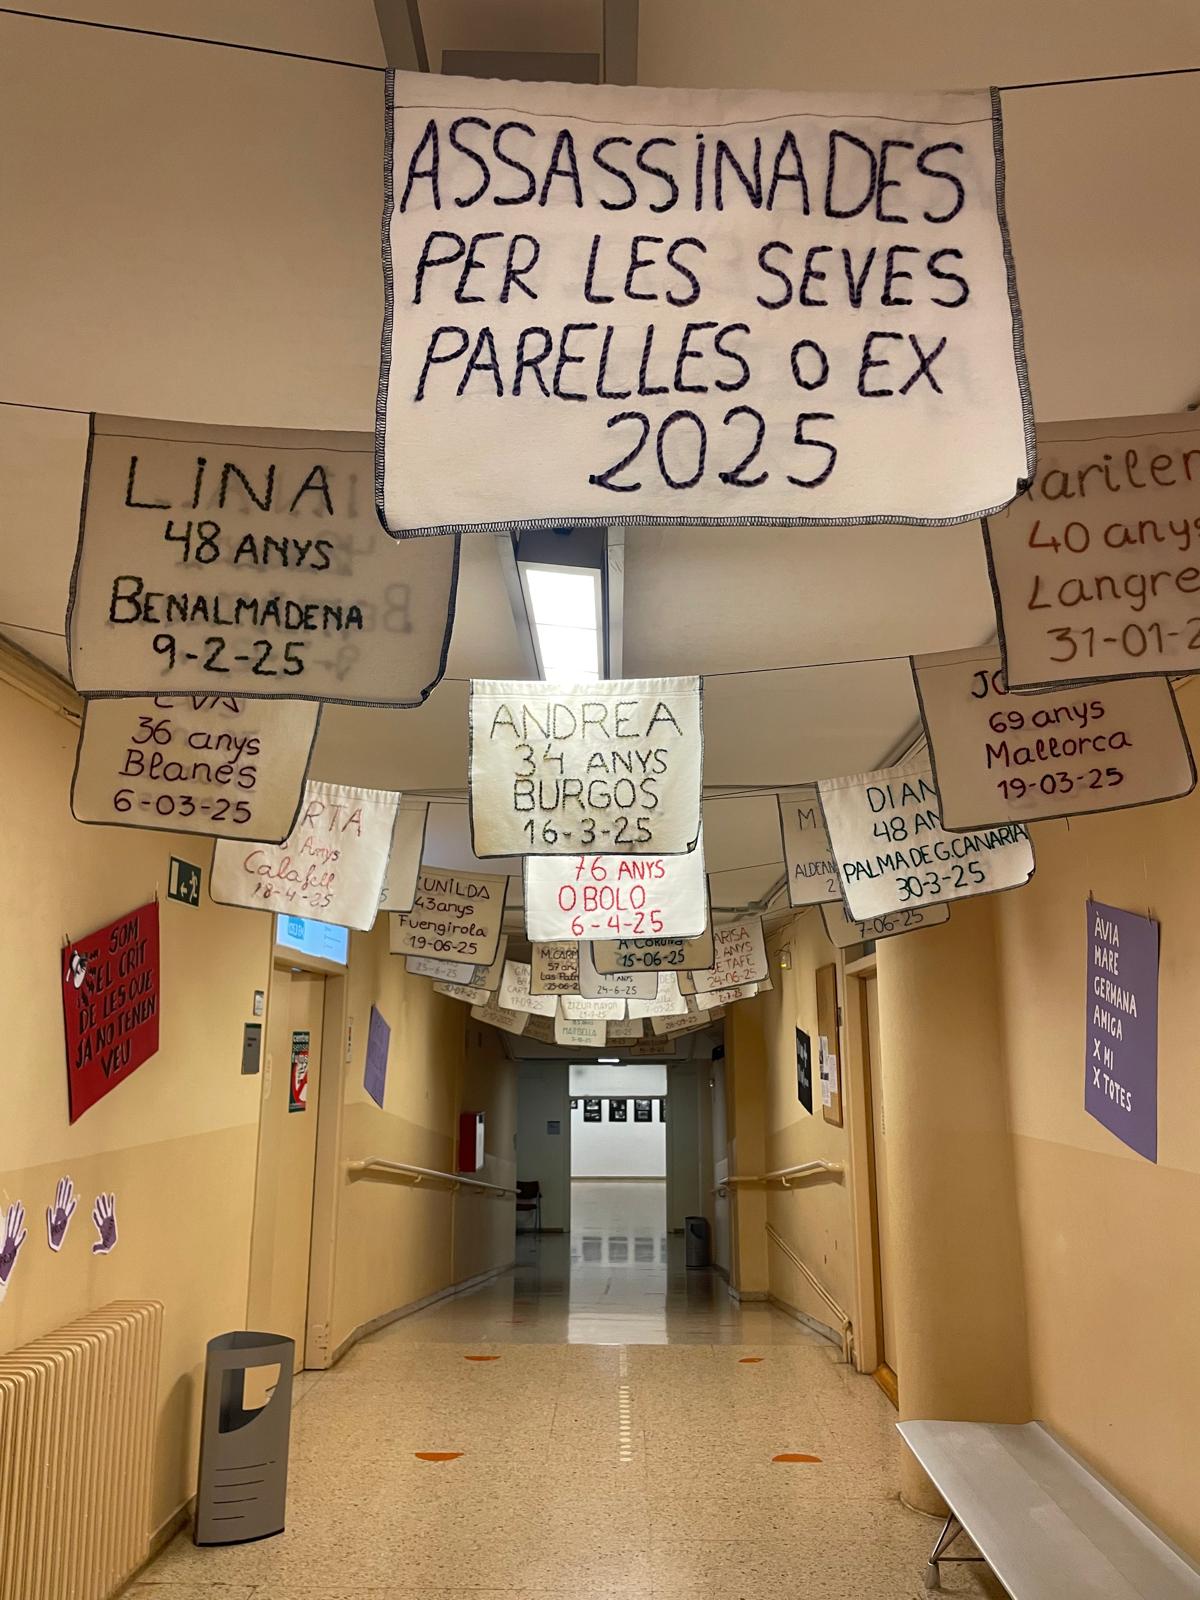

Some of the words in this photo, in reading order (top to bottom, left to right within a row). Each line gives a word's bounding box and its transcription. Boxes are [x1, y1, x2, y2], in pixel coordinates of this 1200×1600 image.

[412, 231, 540, 304] PER
[585, 234, 707, 307] LES
[756, 240, 970, 309] SEVES
[414, 322, 752, 402] PARELLES
[858, 331, 947, 398] EX
[589, 406, 838, 492] 2025
[1020, 449, 1200, 503] arile
[164, 520, 221, 564] 48
[234, 533, 334, 570] ANYS
[1029, 520, 1090, 553] 40
[1028, 566, 1200, 612] Langre
[153, 634, 305, 675] 9-2-25
[490, 701, 683, 740] ANDREA
[989, 711, 1024, 733] 69
[1032, 701, 1105, 728] anys
[132, 716, 171, 745] 36
[188, 732, 260, 764] anys
[985, 731, 1132, 769] Mallorca
[119, 749, 256, 789] Blanes
[514, 743, 564, 778] 34
[586, 749, 669, 775] ANYS
[513, 778, 659, 811] BURGOS
[997, 768, 1124, 799] 19-03-25
[114, 789, 251, 823] 6-03-25
[301, 801, 363, 838] RTA
[797, 808, 816, 831] M
[523, 816, 653, 845] 16-3-25
[873, 816, 907, 843] 48
[575, 856, 607, 882] 76
[618, 860, 665, 881] ANYS
[842, 851, 909, 884] PALMA
[896, 861, 985, 902] 30-3-25
[253, 882, 333, 908] 18-4-25
[417, 876, 490, 900] UNILDA
[558, 885, 577, 911] O
[583, 885, 646, 912] BOLO
[109, 917, 139, 955] SOM
[398, 914, 487, 937] Fuengirola
[571, 909, 663, 936] 6-4-25
[409, 936, 478, 955] 19-06-25
[621, 949, 685, 967] 15-06-25
[1094, 944, 1119, 976] MARE
[597, 986, 638, 995] 24-6-25
[1093, 976, 1138, 1018] GERMANA
[79, 1004, 97, 1035] DE
[103, 984, 126, 1019] LES
[1093, 1004, 1123, 1041] AMIGA
[76, 1033, 93, 1069] JA
[95, 1022, 115, 1054] NO
[116, 995, 157, 1037] TENEN
[101, 1036, 132, 1080] VEU
[1103, 1076, 1132, 1112] TOTES
